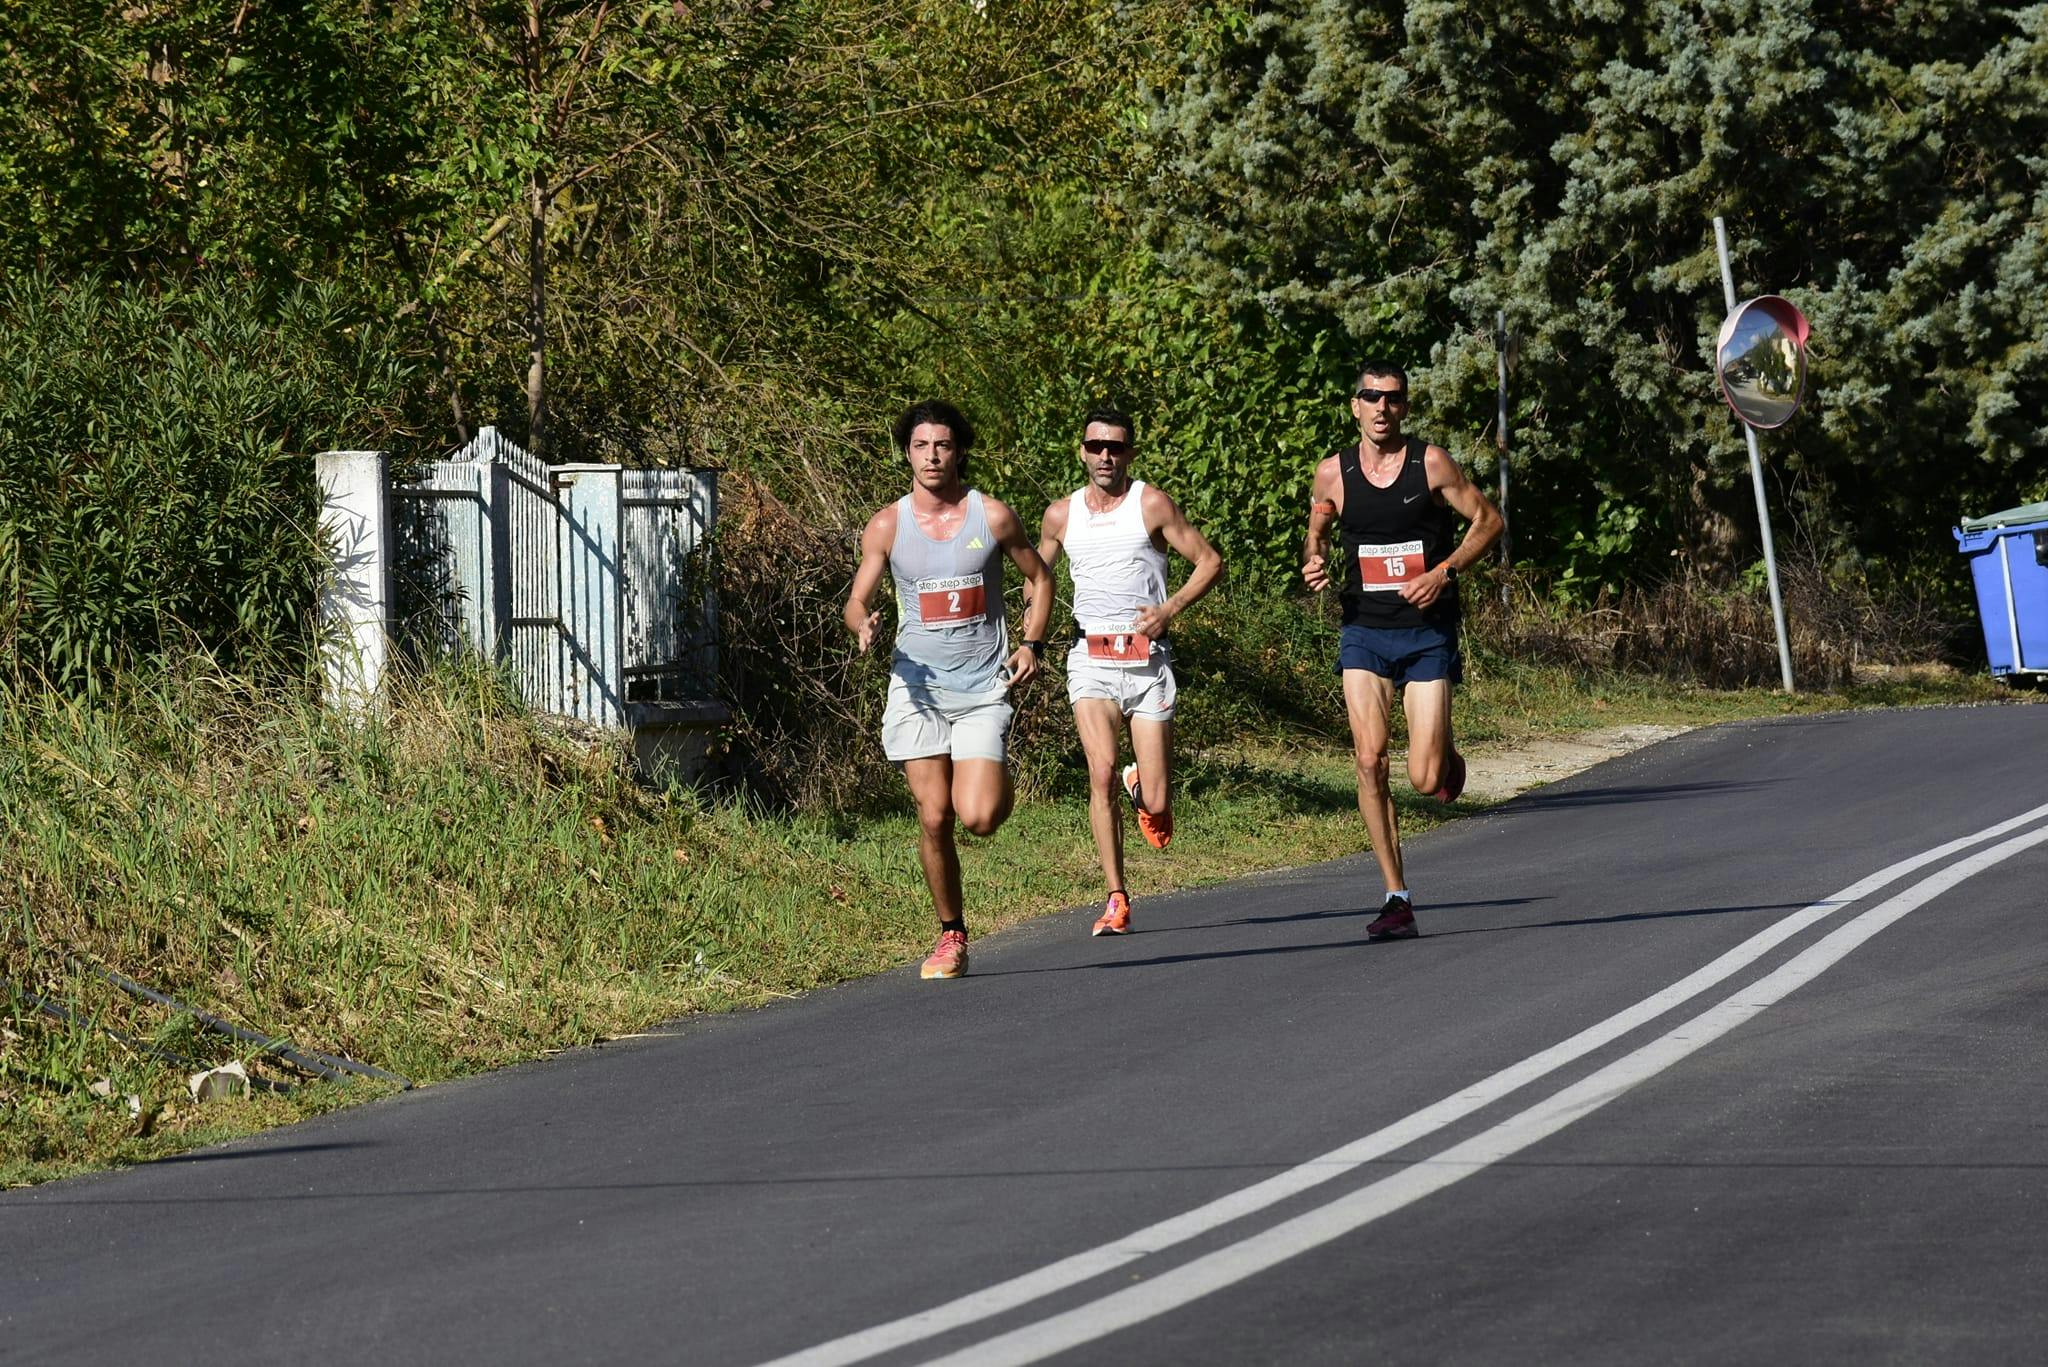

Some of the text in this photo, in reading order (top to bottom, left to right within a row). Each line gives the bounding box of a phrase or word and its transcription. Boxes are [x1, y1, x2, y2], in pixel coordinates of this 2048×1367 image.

[1360, 543, 1421, 556] step step step
[1383, 556, 1406, 577] 15
[918, 575, 981, 591] step step step
[947, 591, 961, 613] 2
[1113, 635, 1126, 654] 4
